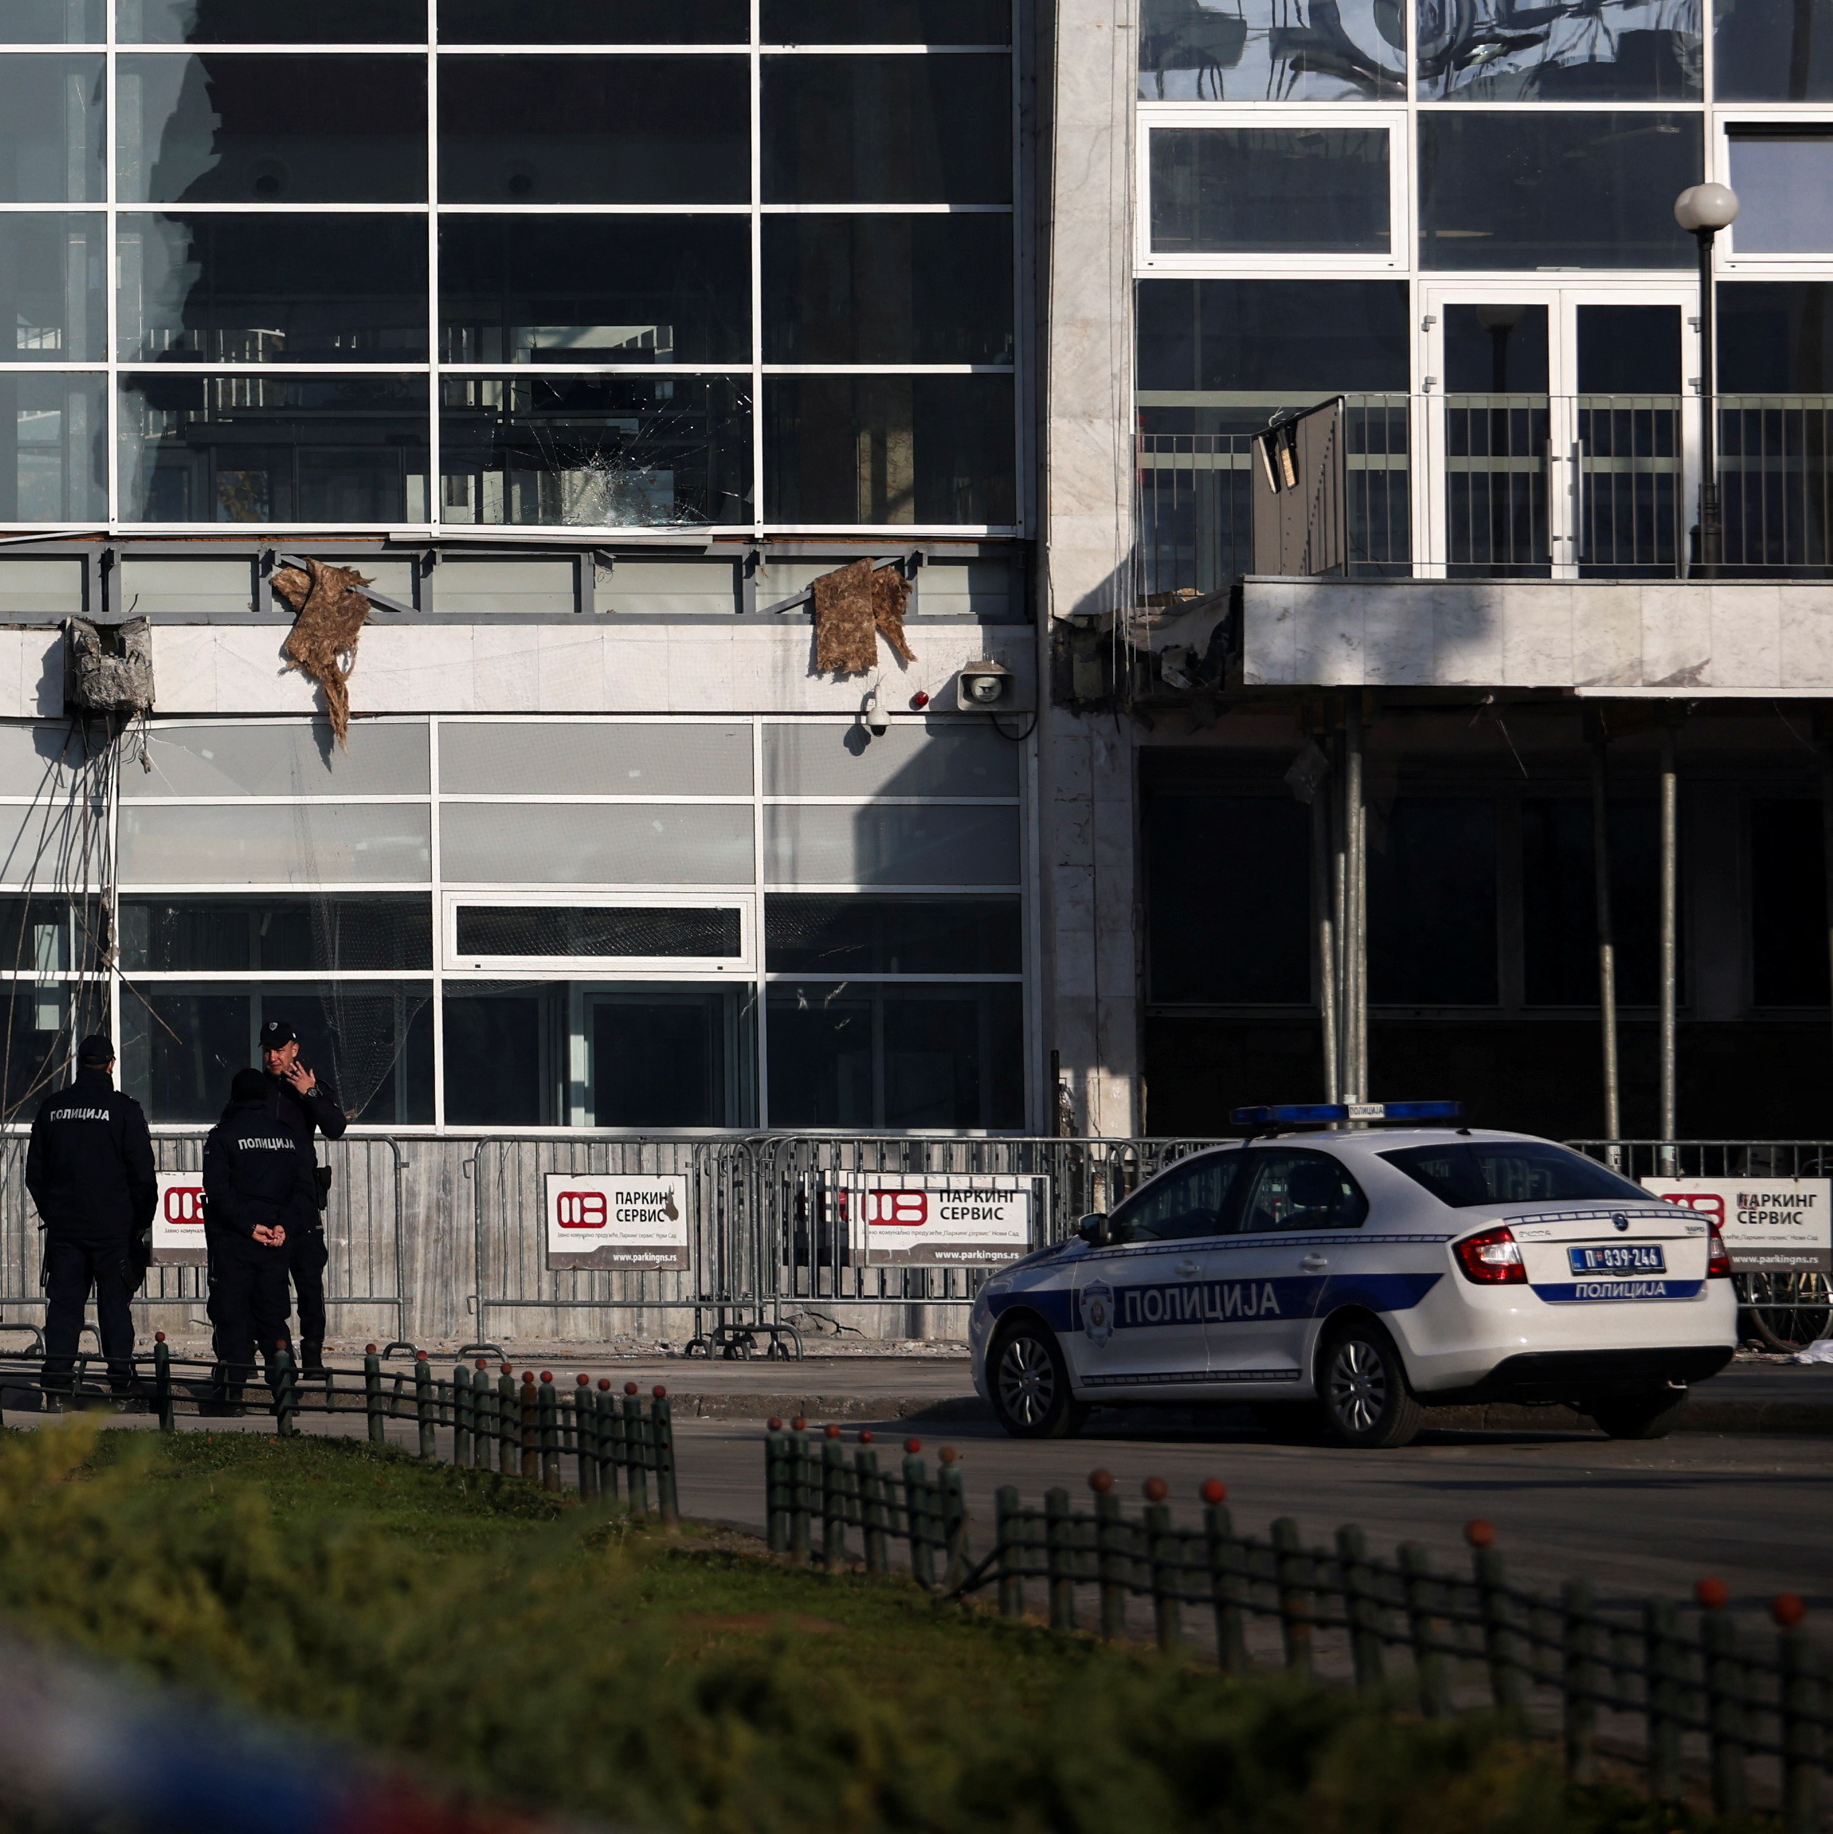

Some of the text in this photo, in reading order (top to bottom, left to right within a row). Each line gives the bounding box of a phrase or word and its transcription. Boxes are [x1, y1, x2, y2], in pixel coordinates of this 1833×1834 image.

[50, 1107, 110, 1122] ПОЛИЦИЈА
[238, 1137, 296, 1151] ПОЛИЦИЈА
[939, 1189, 1018, 1203] ПАРКИНГ
[1737, 1193, 1817, 1208] ПАРКИНГ
[616, 1208, 665, 1223] СЕРВИС
[940, 1206, 1004, 1221] СЕРВИС
[1737, 1211, 1802, 1225] СЕРВИС
[613, 1252, 677, 1264] www.parkingns.rs
[935, 1250, 1020, 1261] www.parkingns.rs
[1732, 1254, 1819, 1265] www.parkingns.rs
[1575, 1281, 1667, 1298] ПОЛИЦИЈА
[1124, 1282, 1281, 1323] ПОЛИЦИЈА
